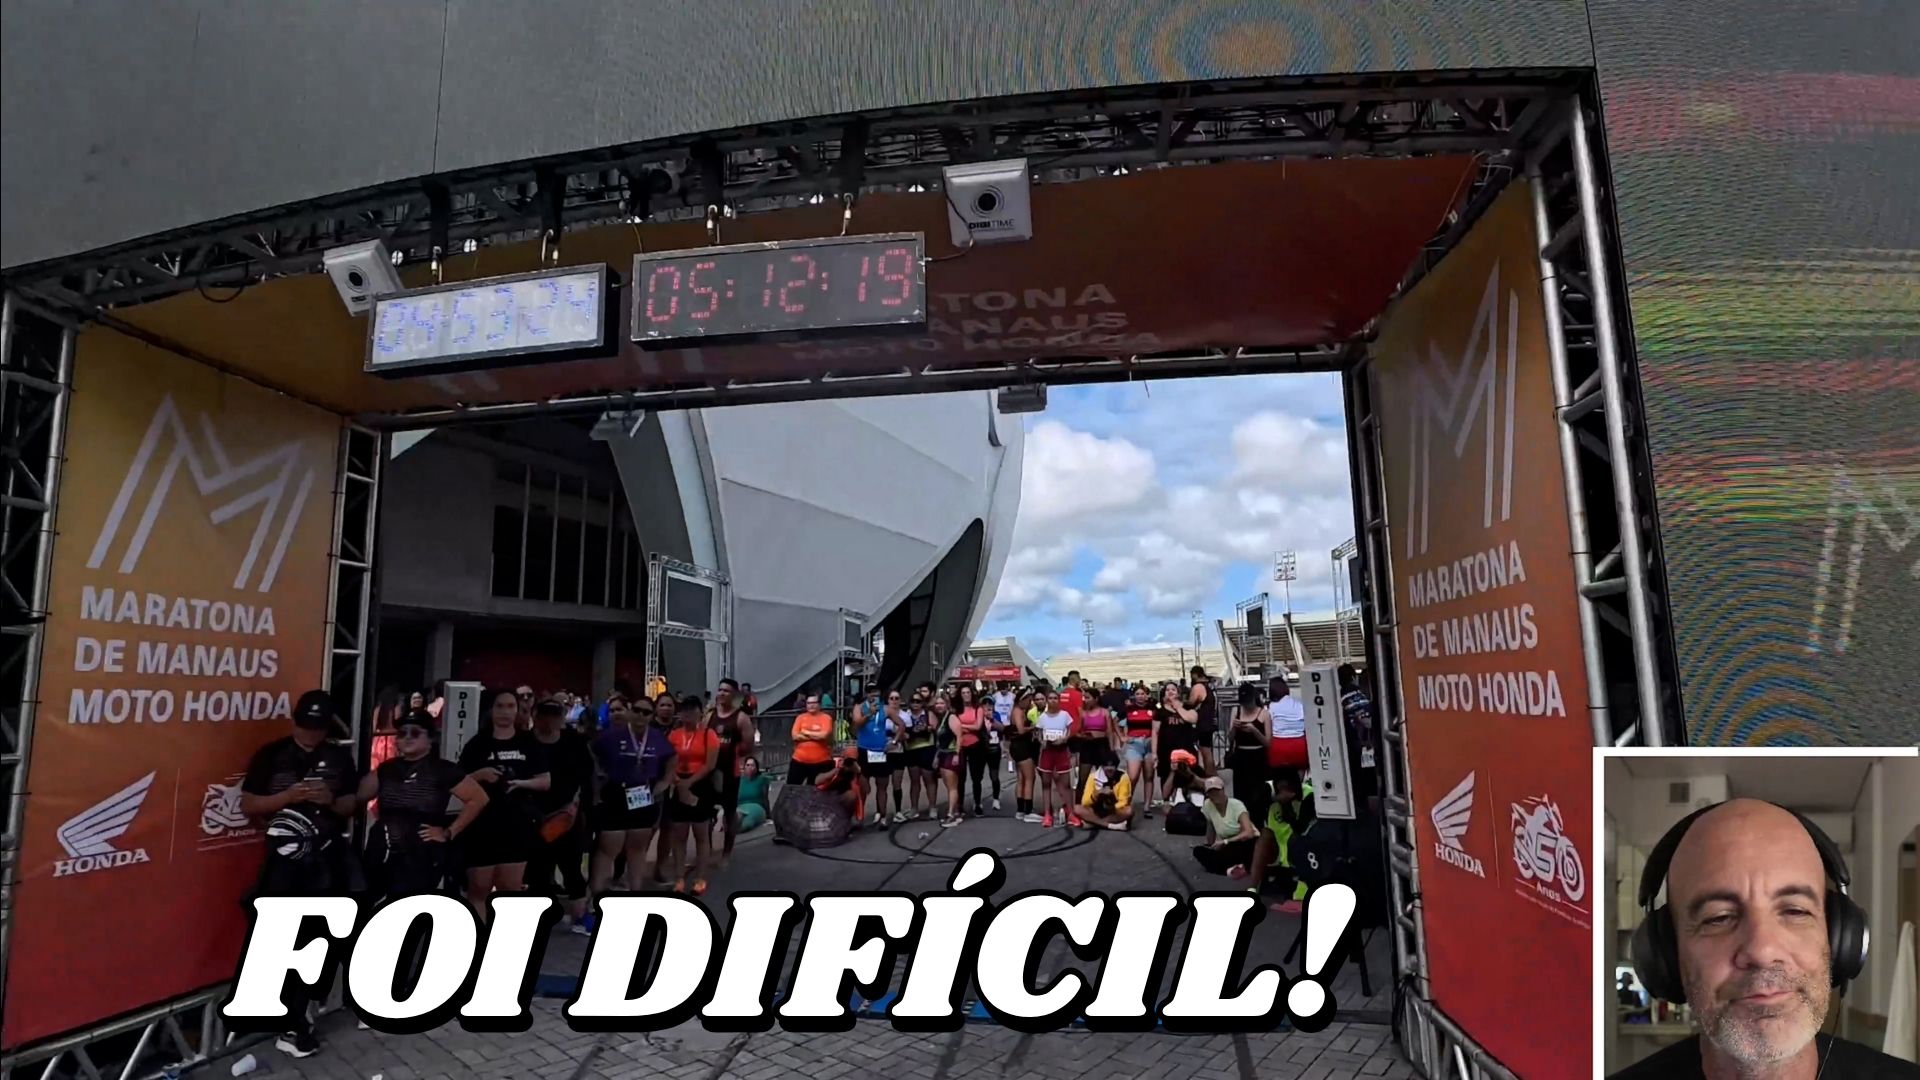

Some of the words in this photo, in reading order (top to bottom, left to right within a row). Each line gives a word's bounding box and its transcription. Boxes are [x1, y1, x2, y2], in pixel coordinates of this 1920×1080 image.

[645, 248, 913, 323] 05:12:19
[926, 311, 1129, 338] ANAUS
[1408, 540, 1527, 609] MARATONA
[80, 585, 276, 637] MARATONA
[1412, 623, 1438, 660] DE
[1442, 603, 1539, 656] MANAUS
[74, 636, 126, 673] DE
[136, 641, 279, 679] MANAUS
[68, 688, 174, 725] MOTO
[182, 690, 293, 723] HONDA
[1418, 672, 1474, 713] MOTO
[1478, 670, 1567, 718] HONDA
[53, 847, 151, 878] HONDA
[1434, 842, 1486, 879] HONDA
